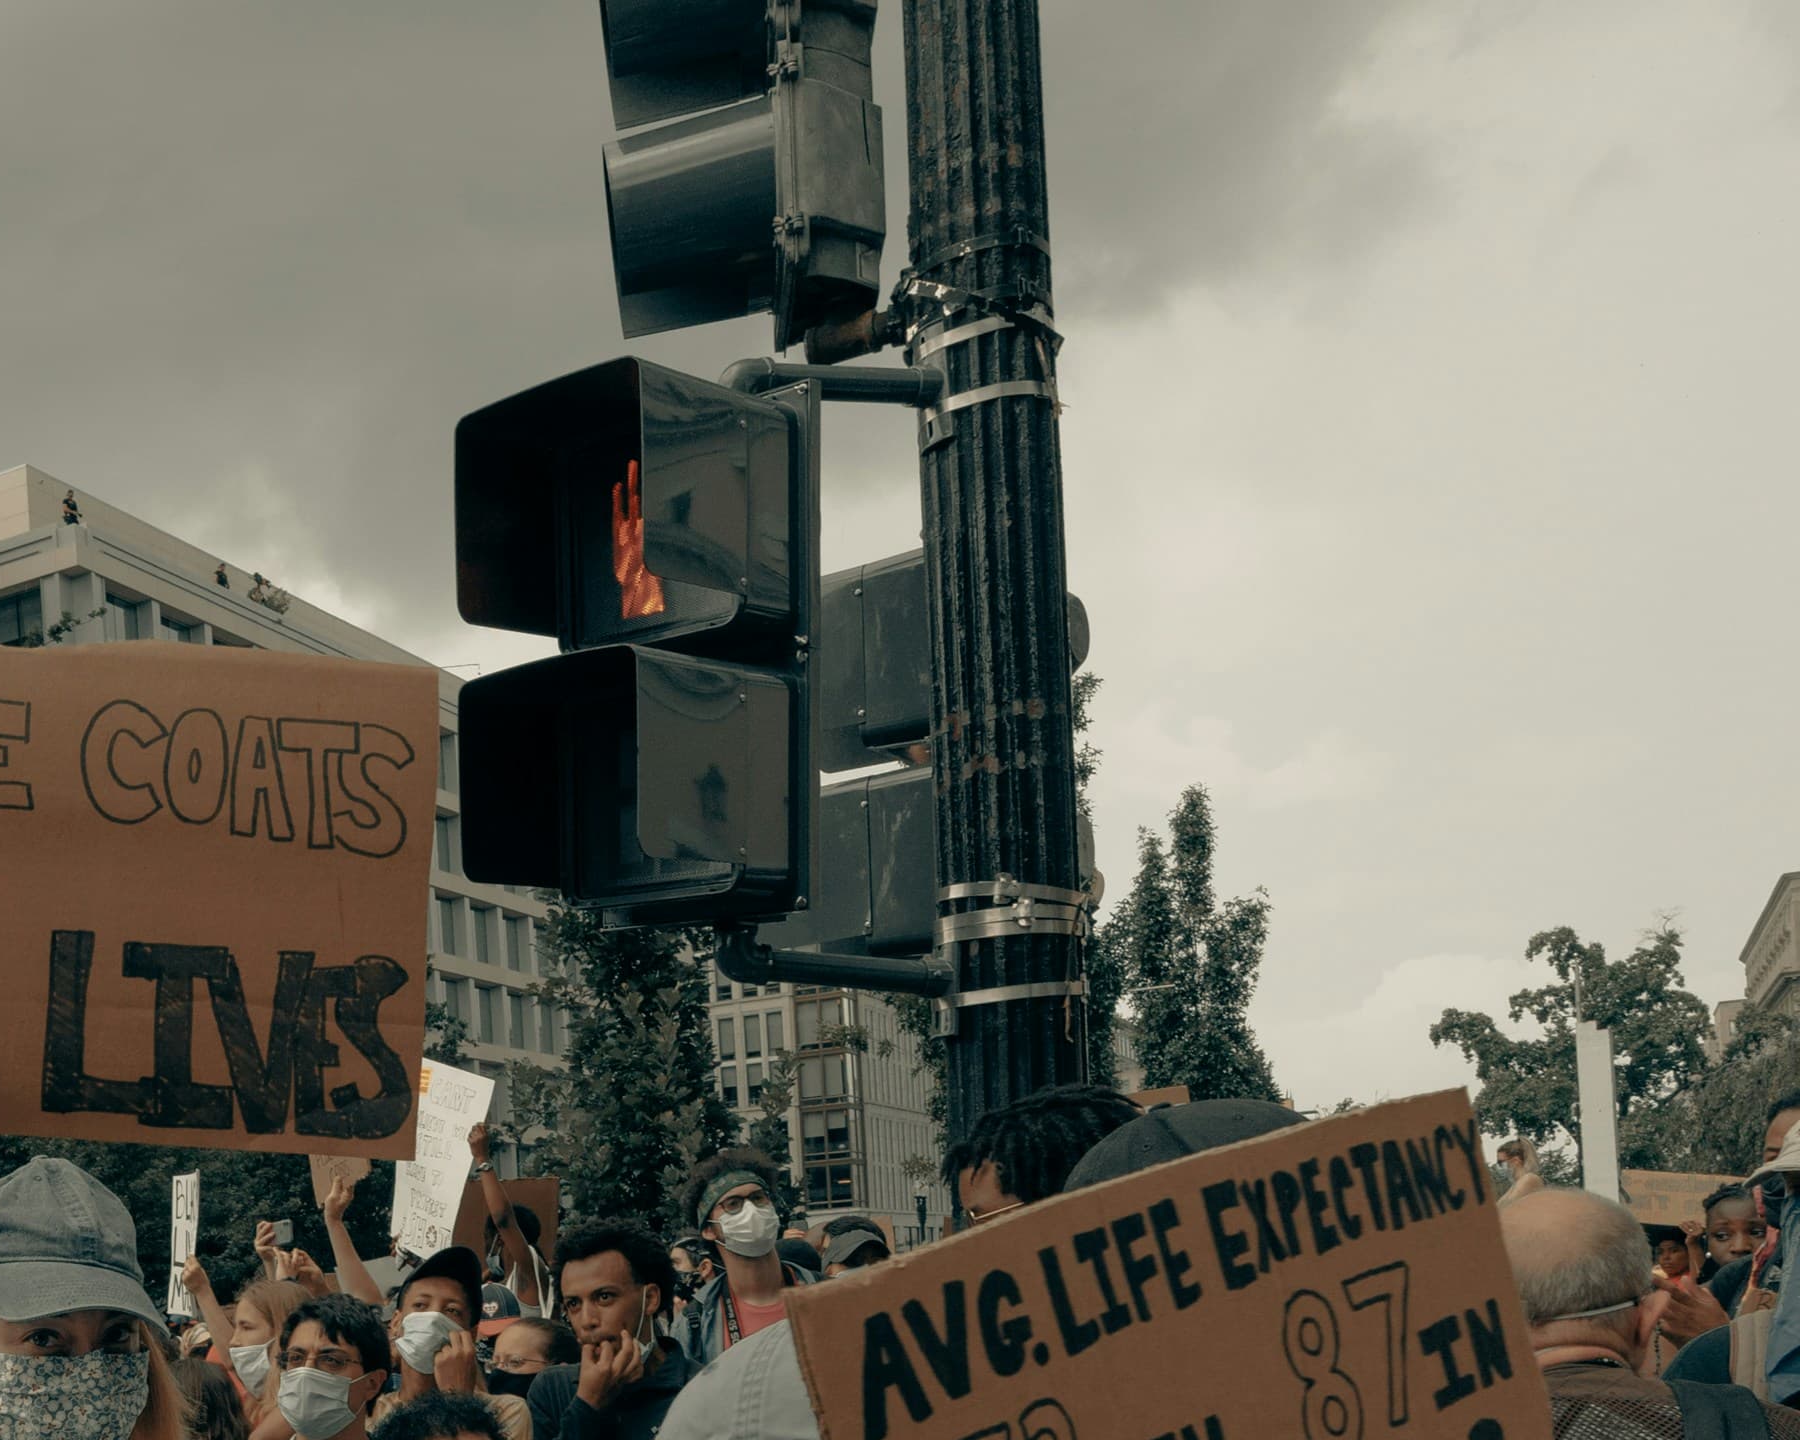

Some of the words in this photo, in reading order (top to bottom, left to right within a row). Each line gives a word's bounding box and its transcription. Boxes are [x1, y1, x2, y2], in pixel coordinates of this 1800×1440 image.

[81, 699, 415, 859] COATS
[41, 928, 413, 1140] LIVES
[1038, 1198, 1202, 1358] LIFE
[1200, 1118, 1490, 1291] EXPECTANCY
[1417, 1298, 1513, 1412] IN
